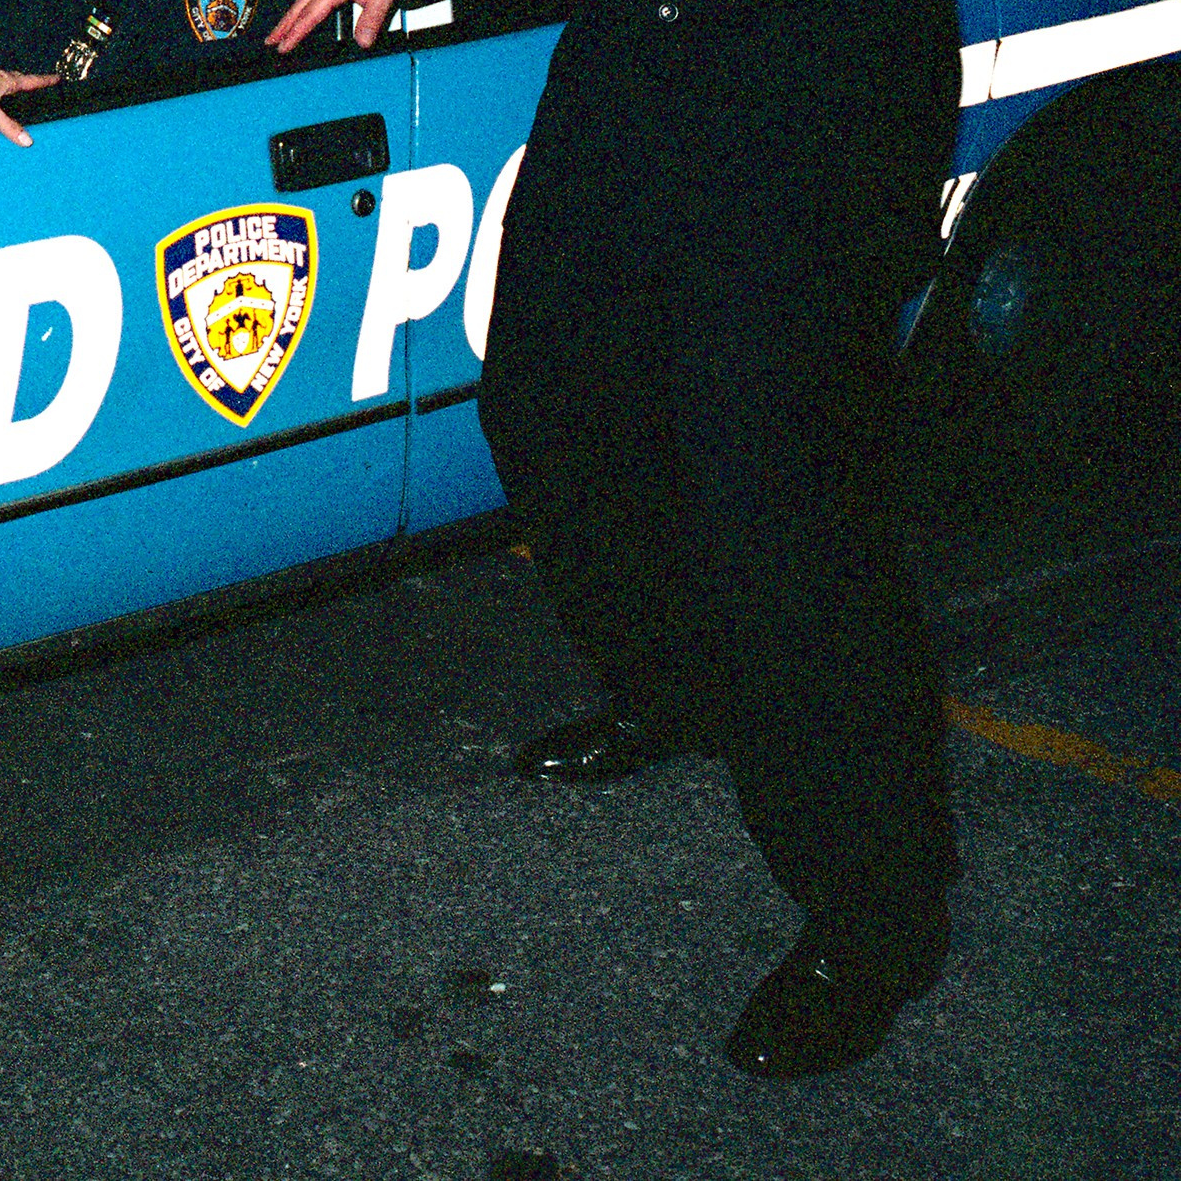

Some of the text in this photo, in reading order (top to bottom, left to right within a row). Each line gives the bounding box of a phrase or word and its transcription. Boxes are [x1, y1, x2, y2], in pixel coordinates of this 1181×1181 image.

[192, 7, 205, 28] CITY
[194, 216, 278, 255] POLICE
[168, 239, 306, 299] DEPARTMENT
[174, 316, 226, 392] CITY OF
[250, 276, 308, 392] NEW YORK
